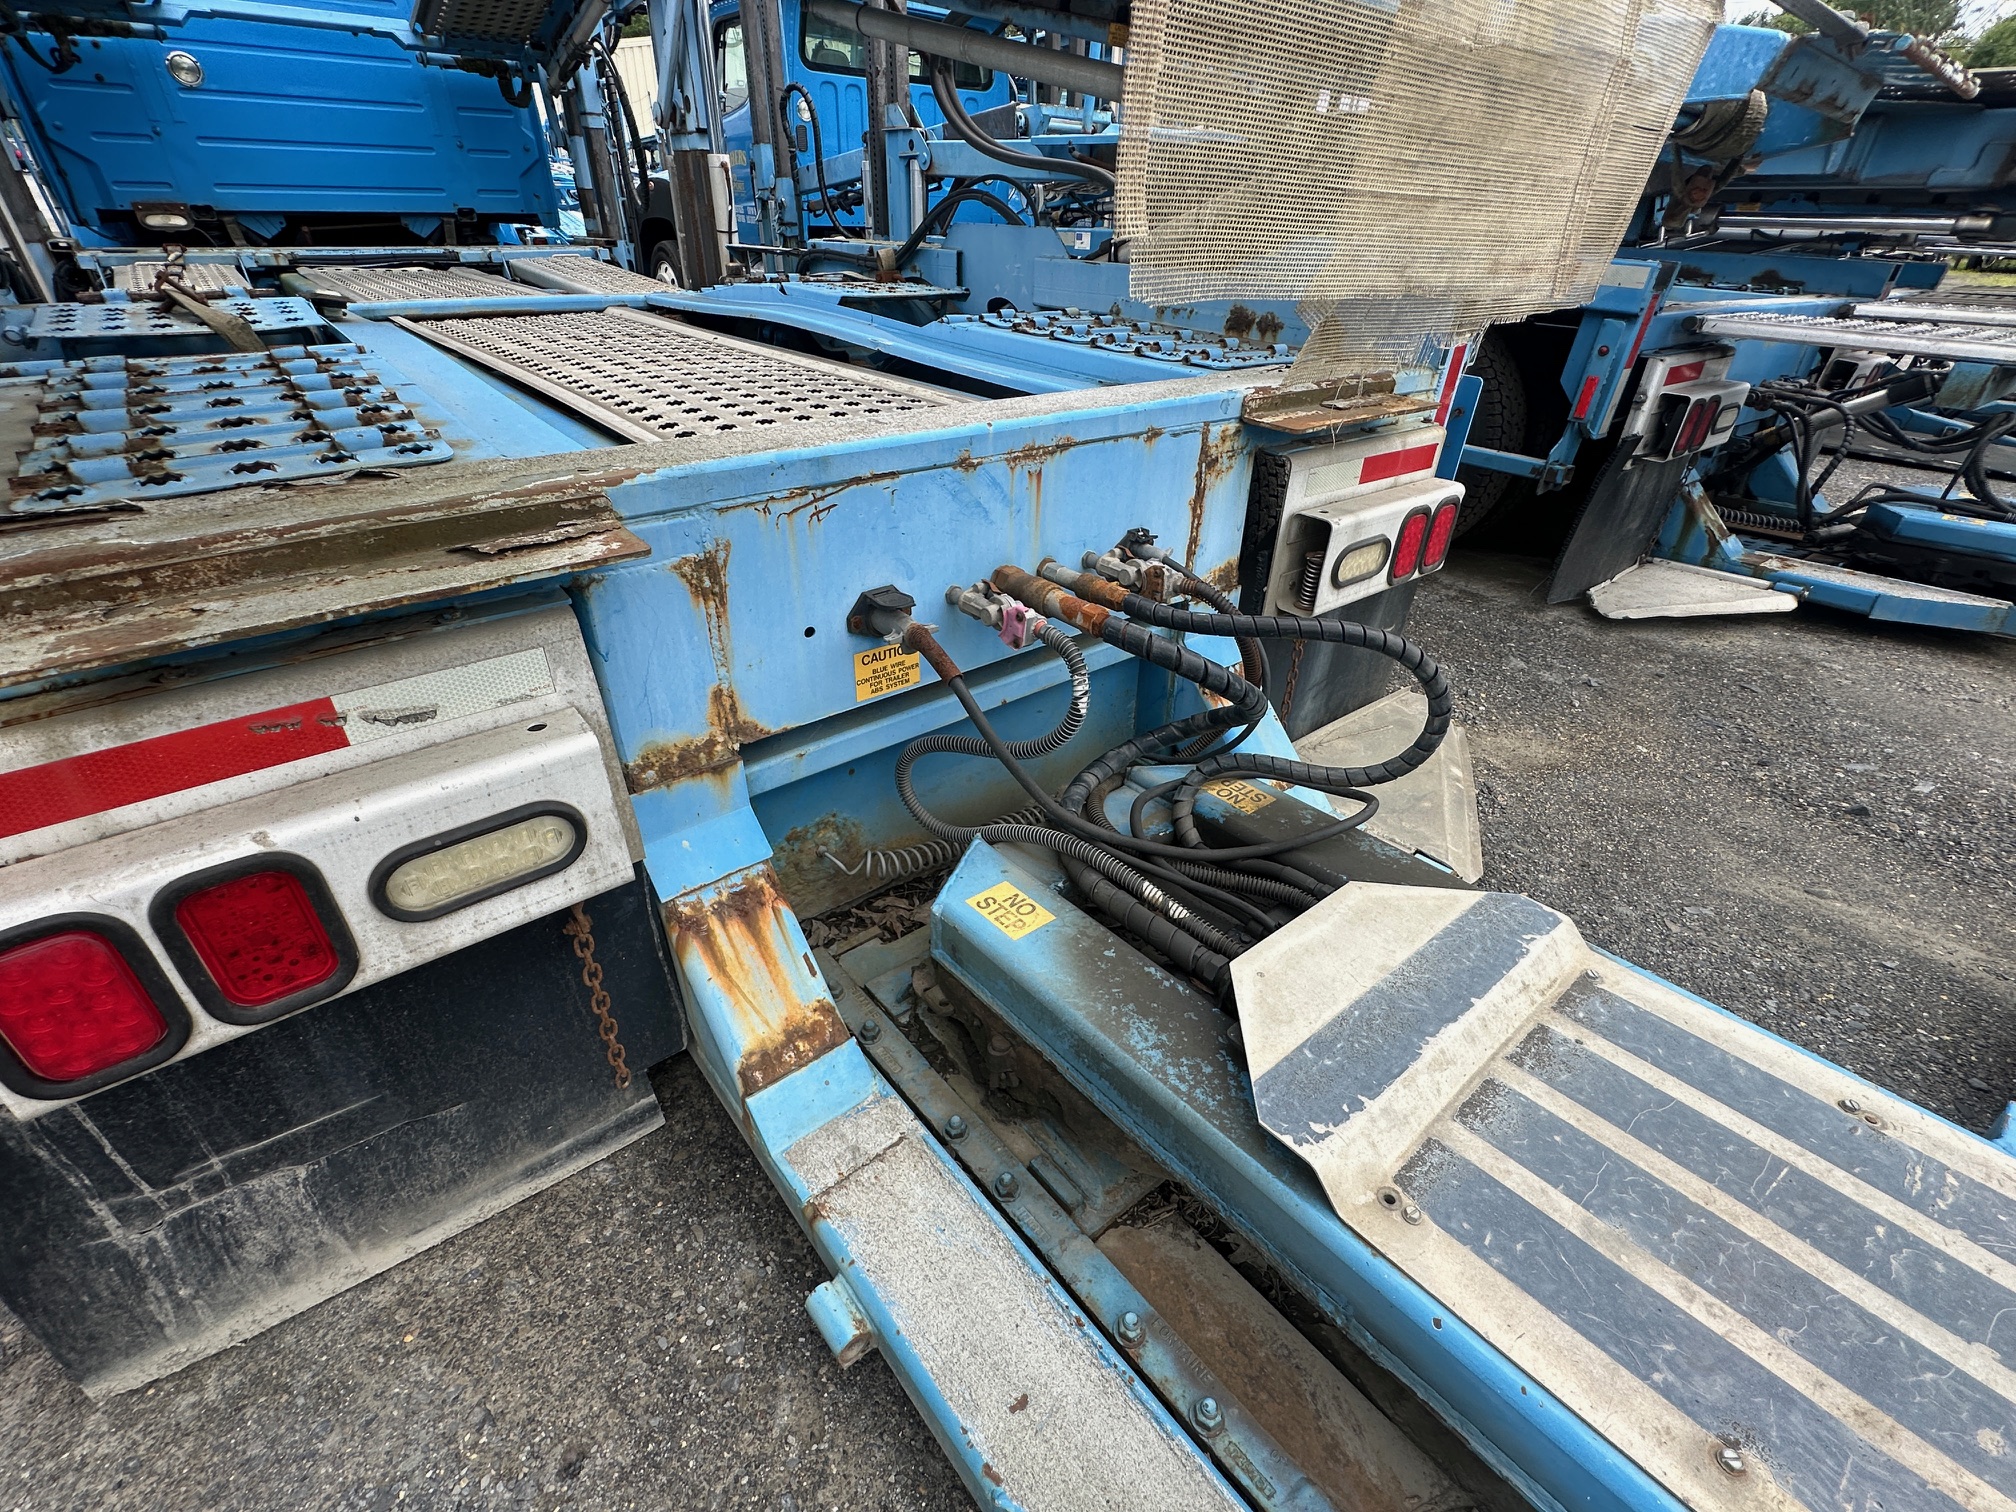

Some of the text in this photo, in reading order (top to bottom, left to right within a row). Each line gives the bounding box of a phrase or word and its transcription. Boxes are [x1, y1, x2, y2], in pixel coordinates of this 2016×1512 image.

[861, 646, 903, 666] CAUTIO
[856, 662, 920, 687] CONTINUOUS POWER
[872, 660, 906, 675] BLUE WIRE
[885, 672, 910, 683] TRAILER
[885, 678, 911, 690] SYSTEM
[1216, 788, 1246, 805] NO
[1220, 779, 1268, 803] STEP
[976, 896, 1027, 931] STEP
[1002, 893, 1037, 916] NO
[1151, 1317, 1215, 1386] FONTAINE
